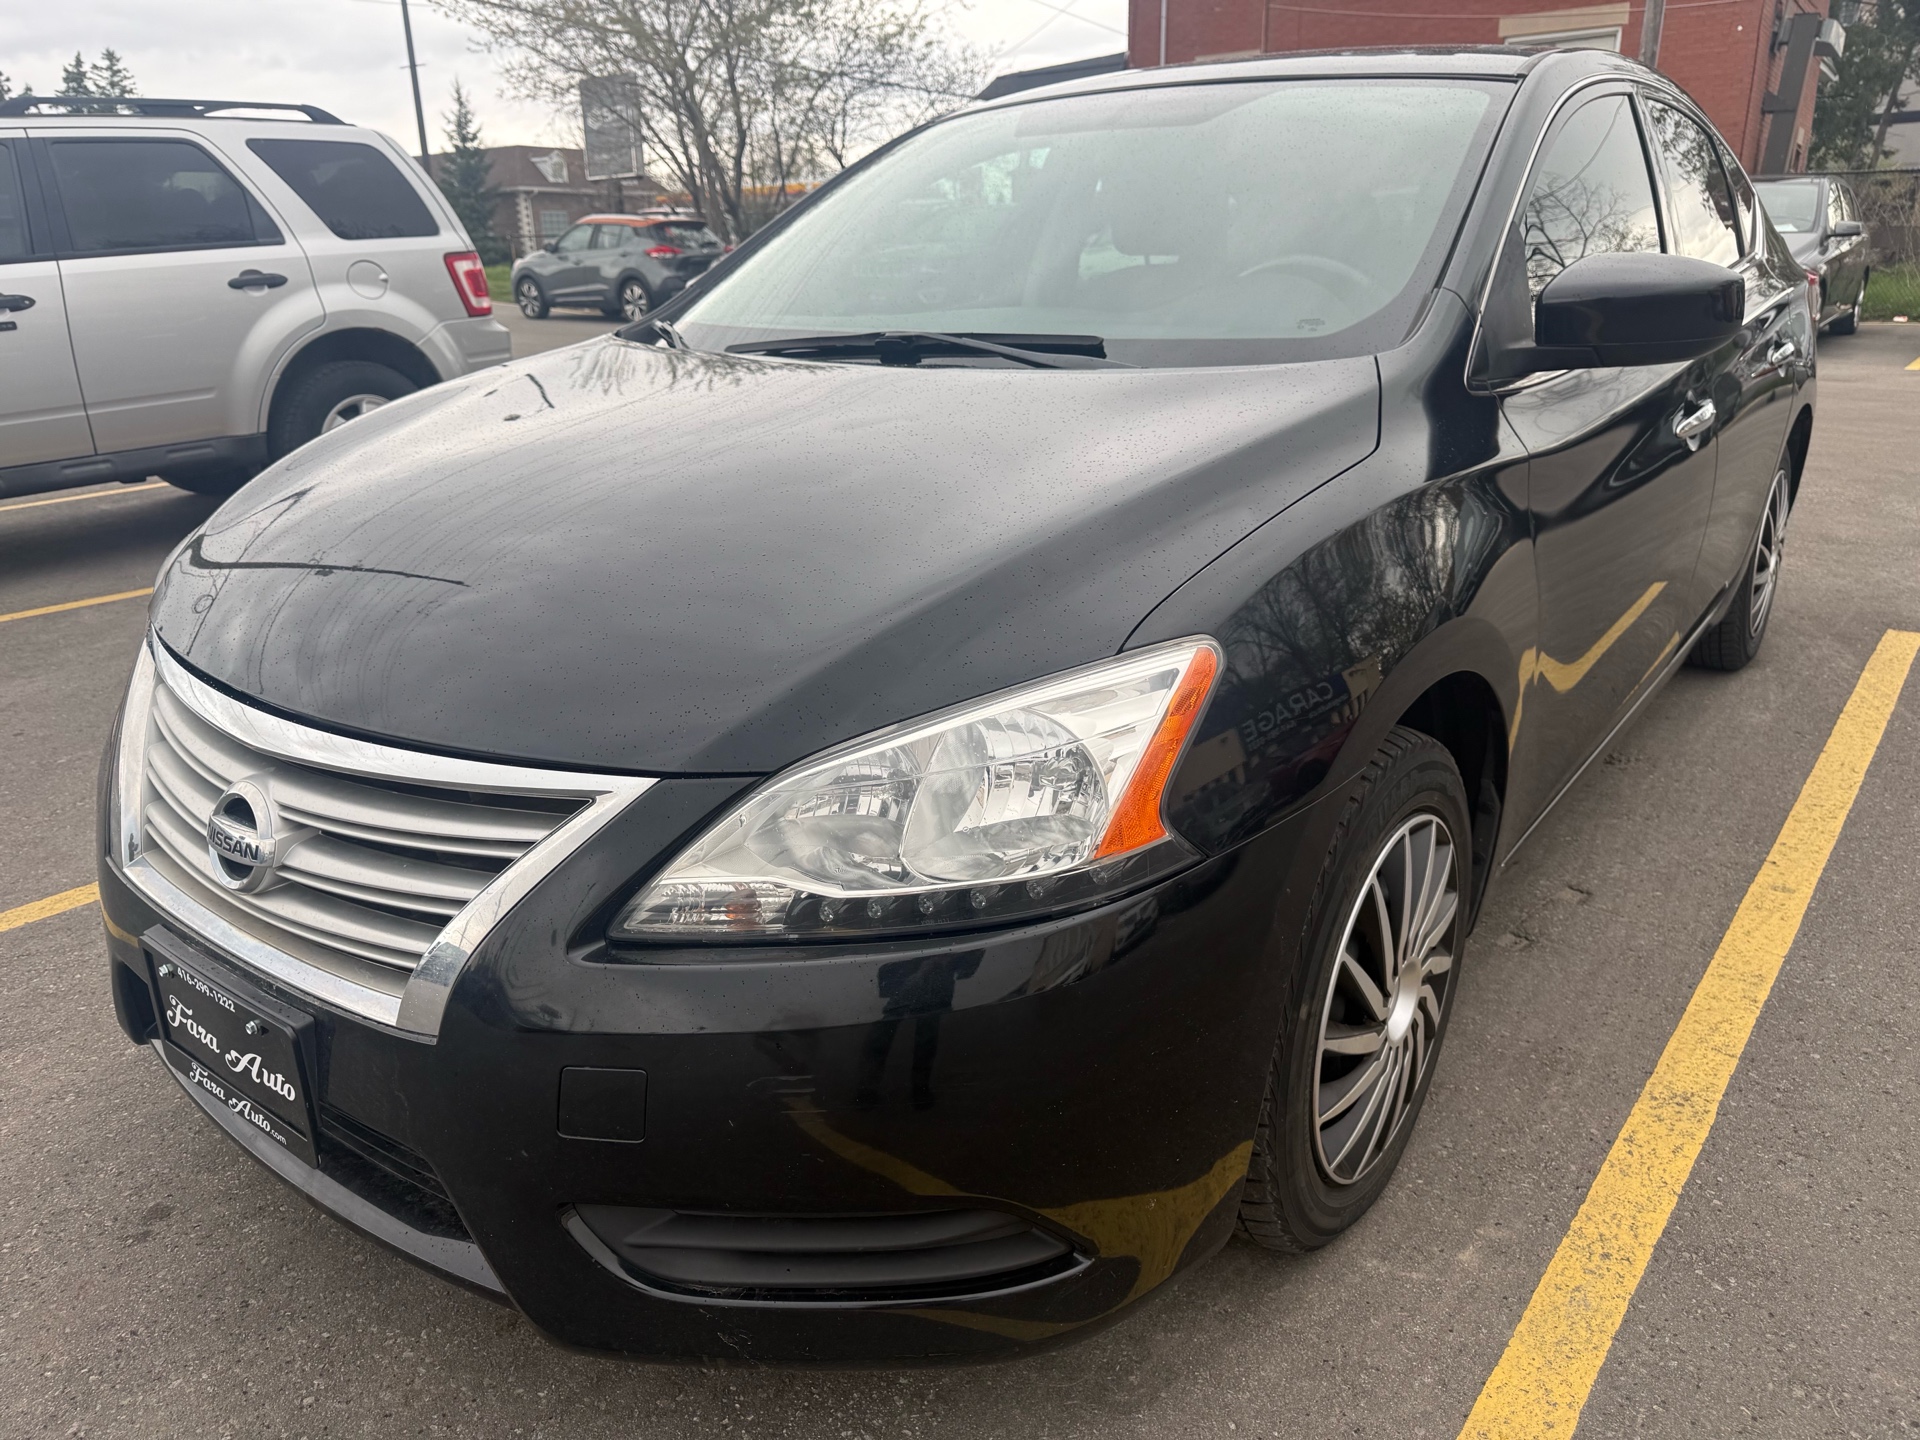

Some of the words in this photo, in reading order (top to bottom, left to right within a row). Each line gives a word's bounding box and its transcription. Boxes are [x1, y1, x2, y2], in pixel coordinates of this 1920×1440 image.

[207, 823, 260, 861] NISSAN
[177, 966, 236, 1013] 416-299-1222
[166, 994, 220, 1054] Fara
[225, 1049, 296, 1101] Auto
[189, 1061, 226, 1100] Fara
